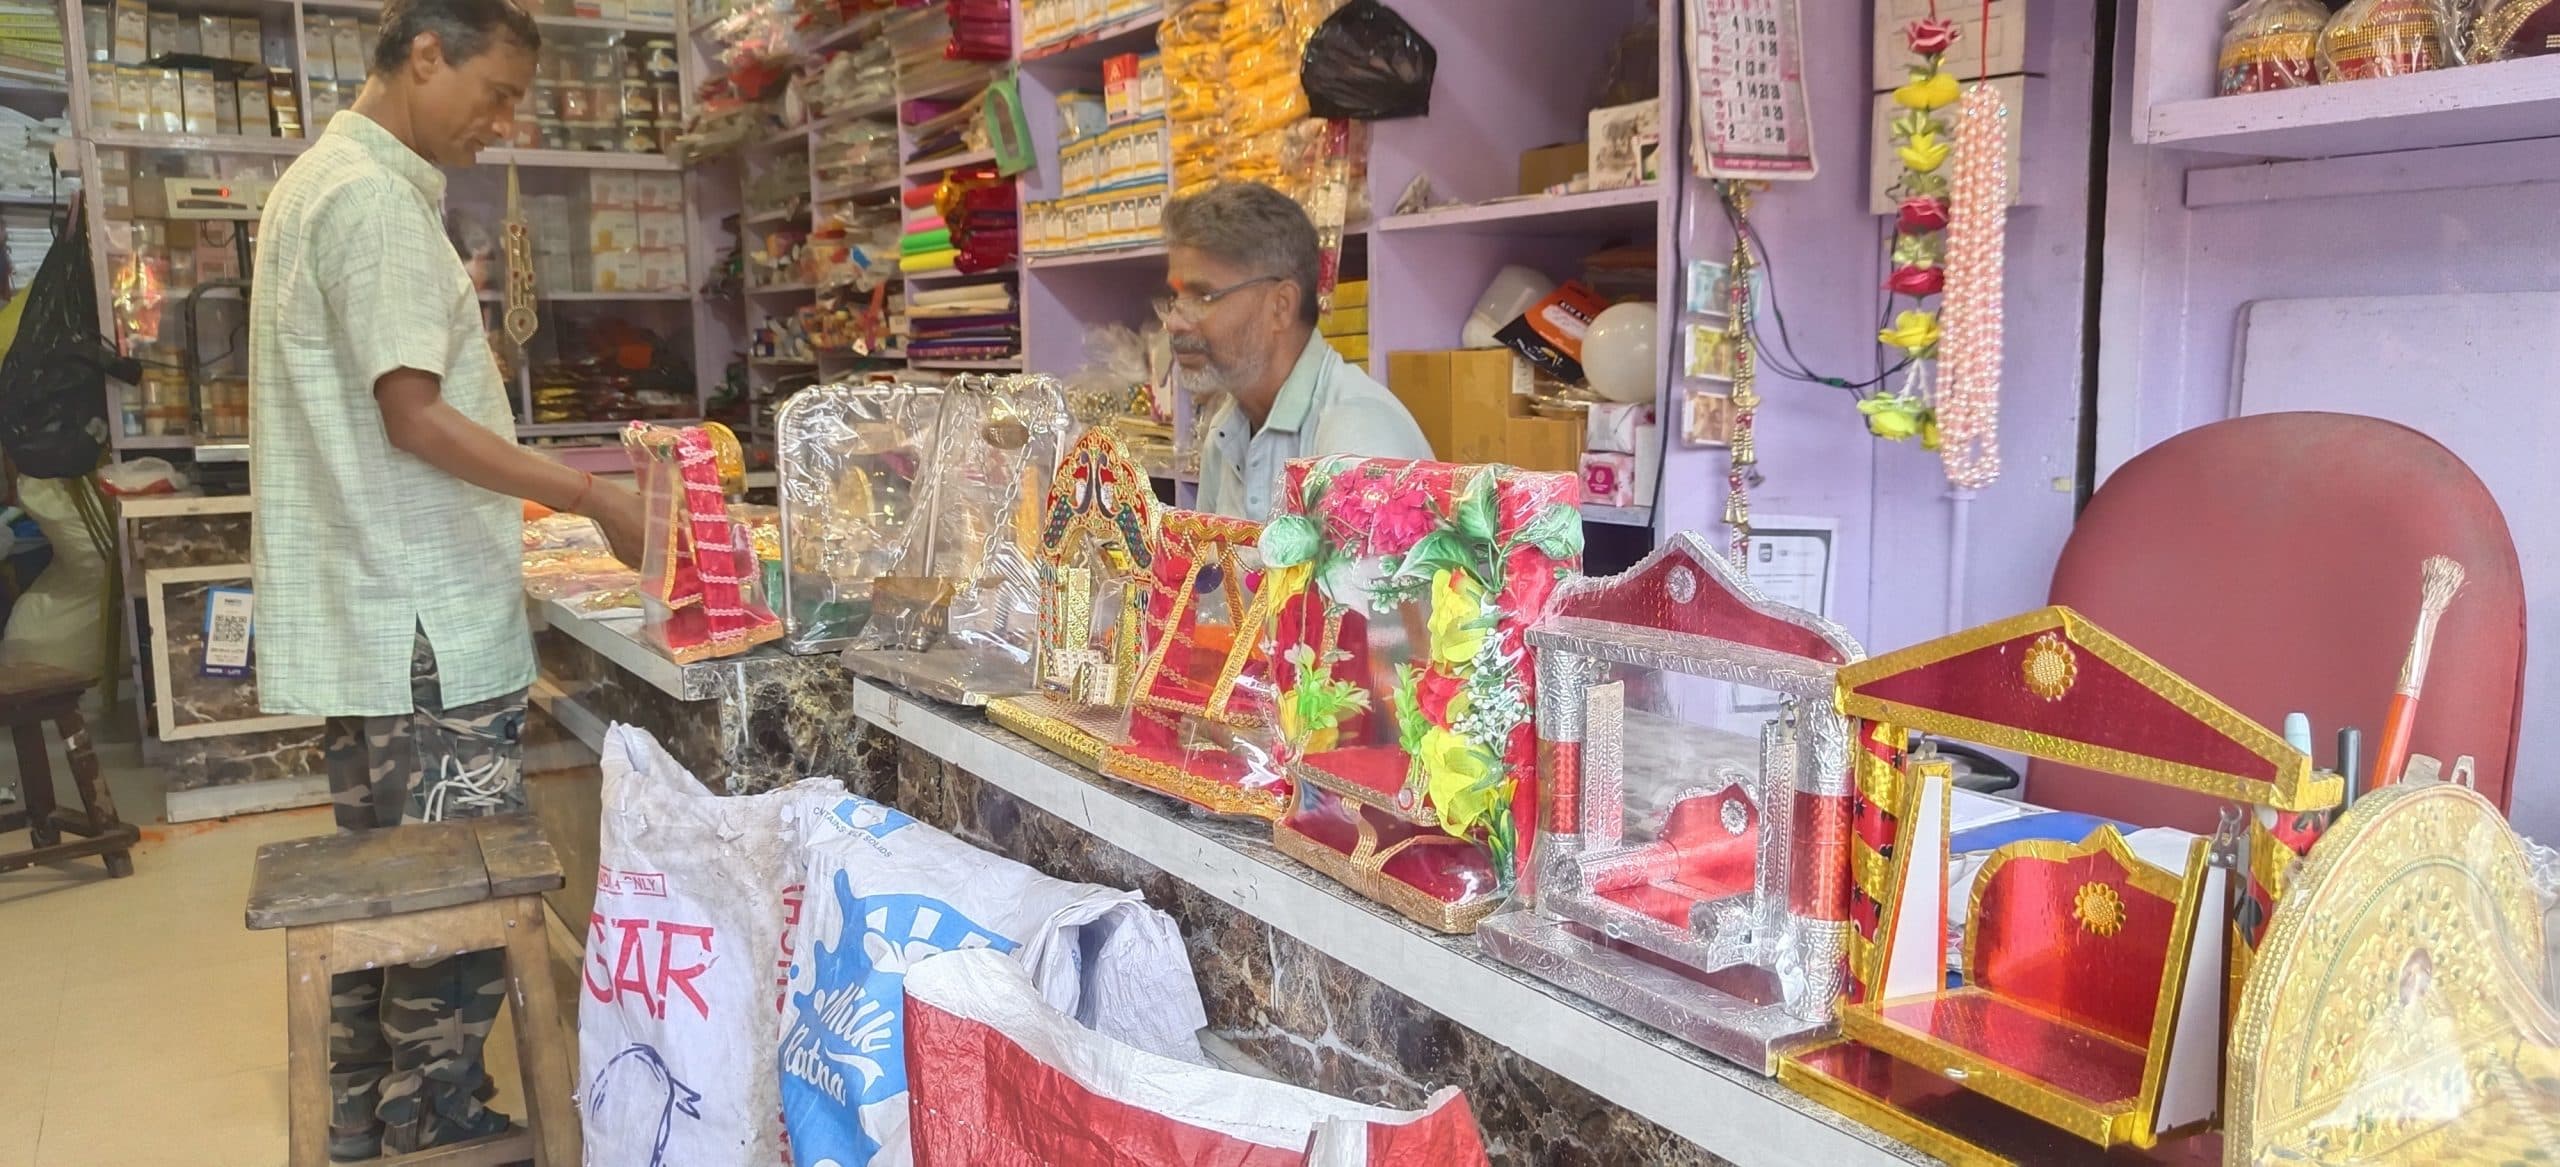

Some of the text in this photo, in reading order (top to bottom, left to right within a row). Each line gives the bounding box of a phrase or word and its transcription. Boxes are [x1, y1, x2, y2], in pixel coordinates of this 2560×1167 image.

[1747, 82, 1757, 99] 14
[1729, 123, 1735, 140] 2
[863, 834, 893, 858] SOLIDS
[813, 982, 895, 1054] Milk
